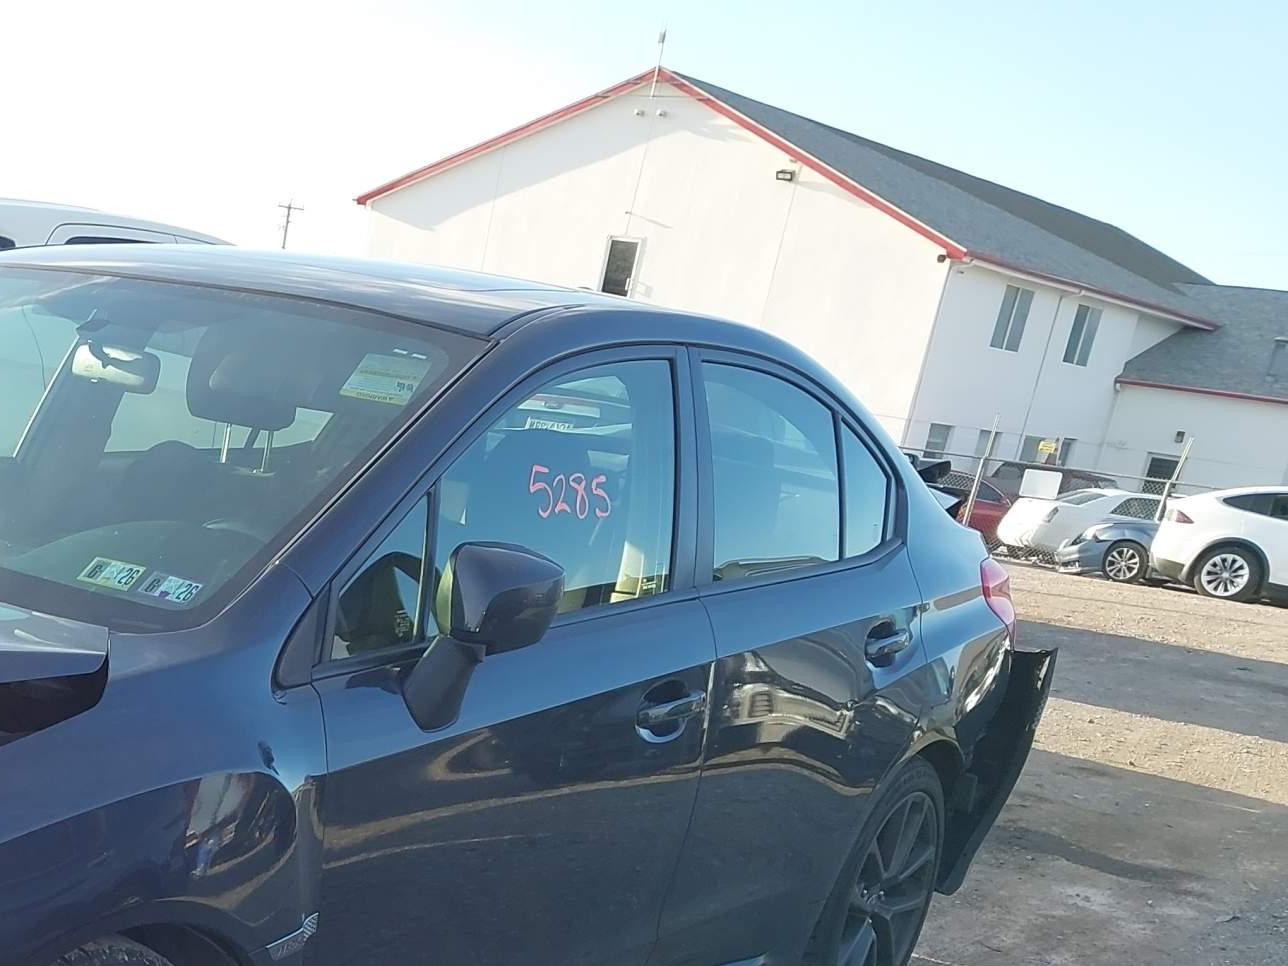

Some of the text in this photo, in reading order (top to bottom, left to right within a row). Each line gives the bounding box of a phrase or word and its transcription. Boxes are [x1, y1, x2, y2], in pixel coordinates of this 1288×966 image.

[529, 464, 612, 519] 5285
[117, 567, 140, 586] 26
[175, 583, 200, 602] 26
